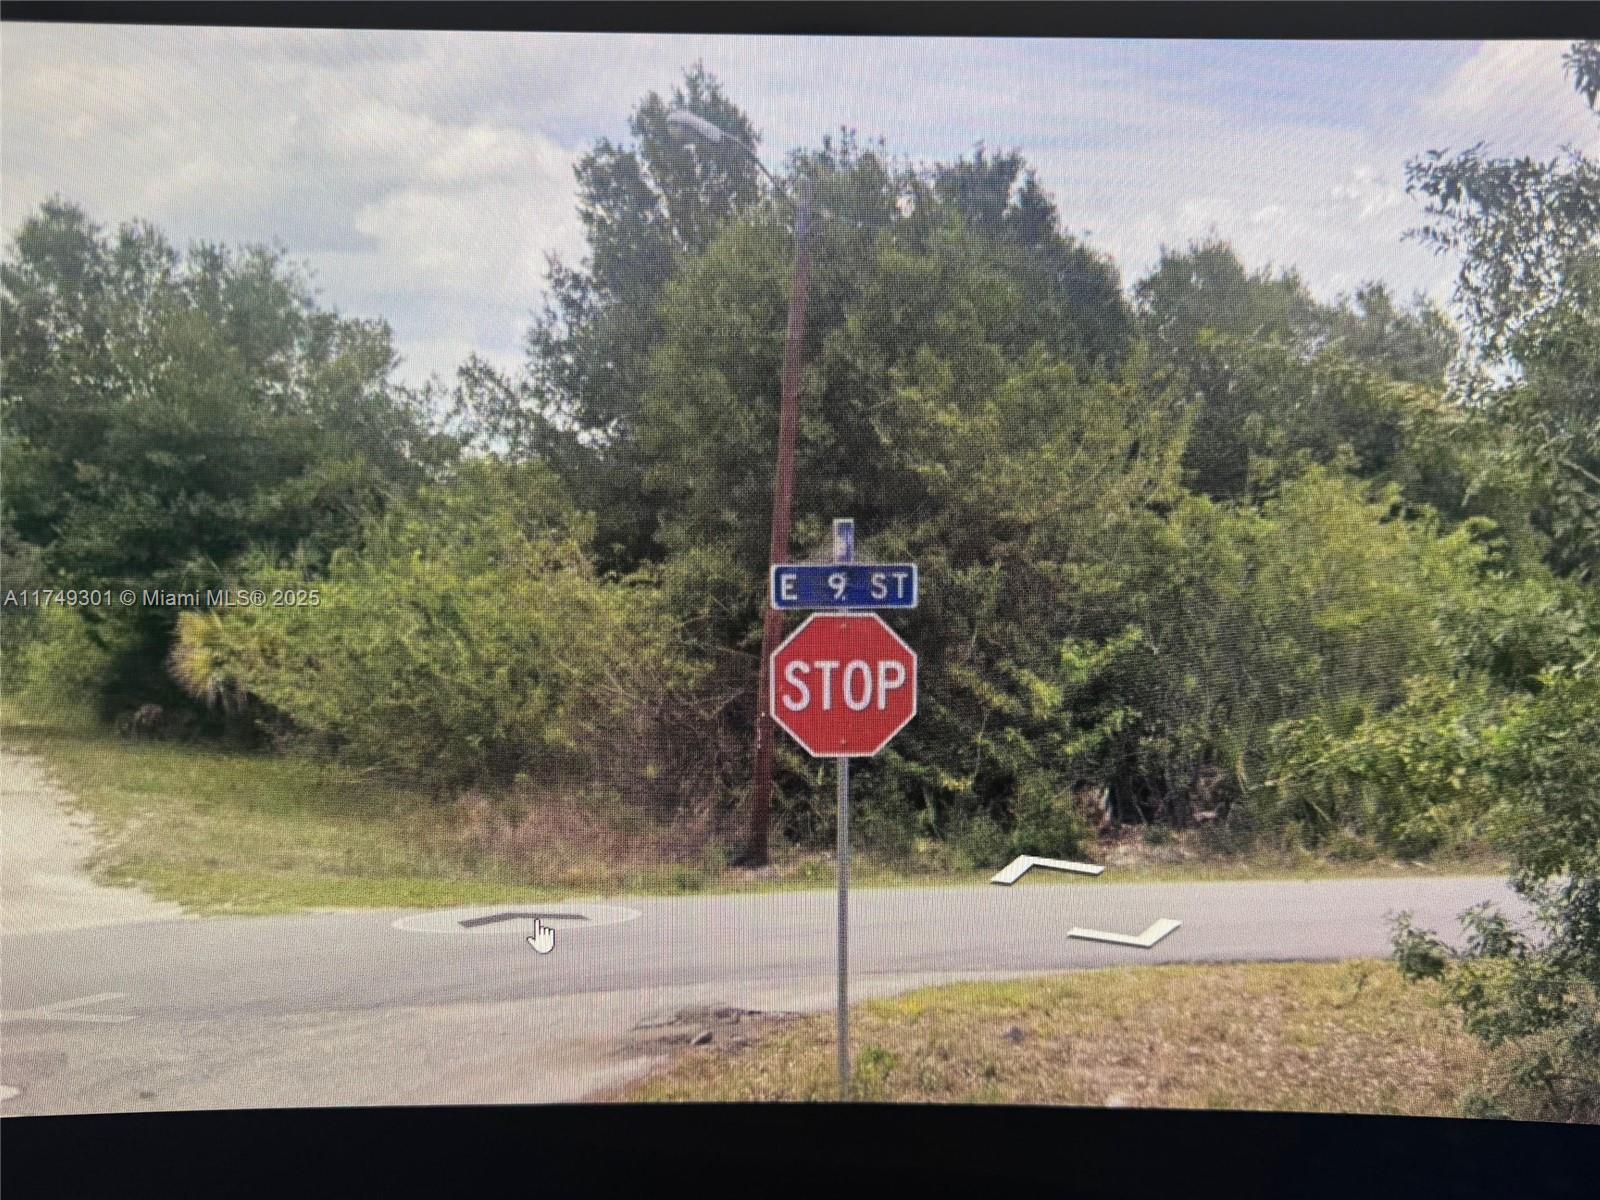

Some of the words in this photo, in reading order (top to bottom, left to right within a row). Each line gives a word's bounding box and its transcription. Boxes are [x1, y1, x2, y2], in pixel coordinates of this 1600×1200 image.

[781, 573, 798, 600] E
[828, 572, 846, 600] 9
[870, 572, 909, 600] ST
[783, 660, 906, 711] STOP
